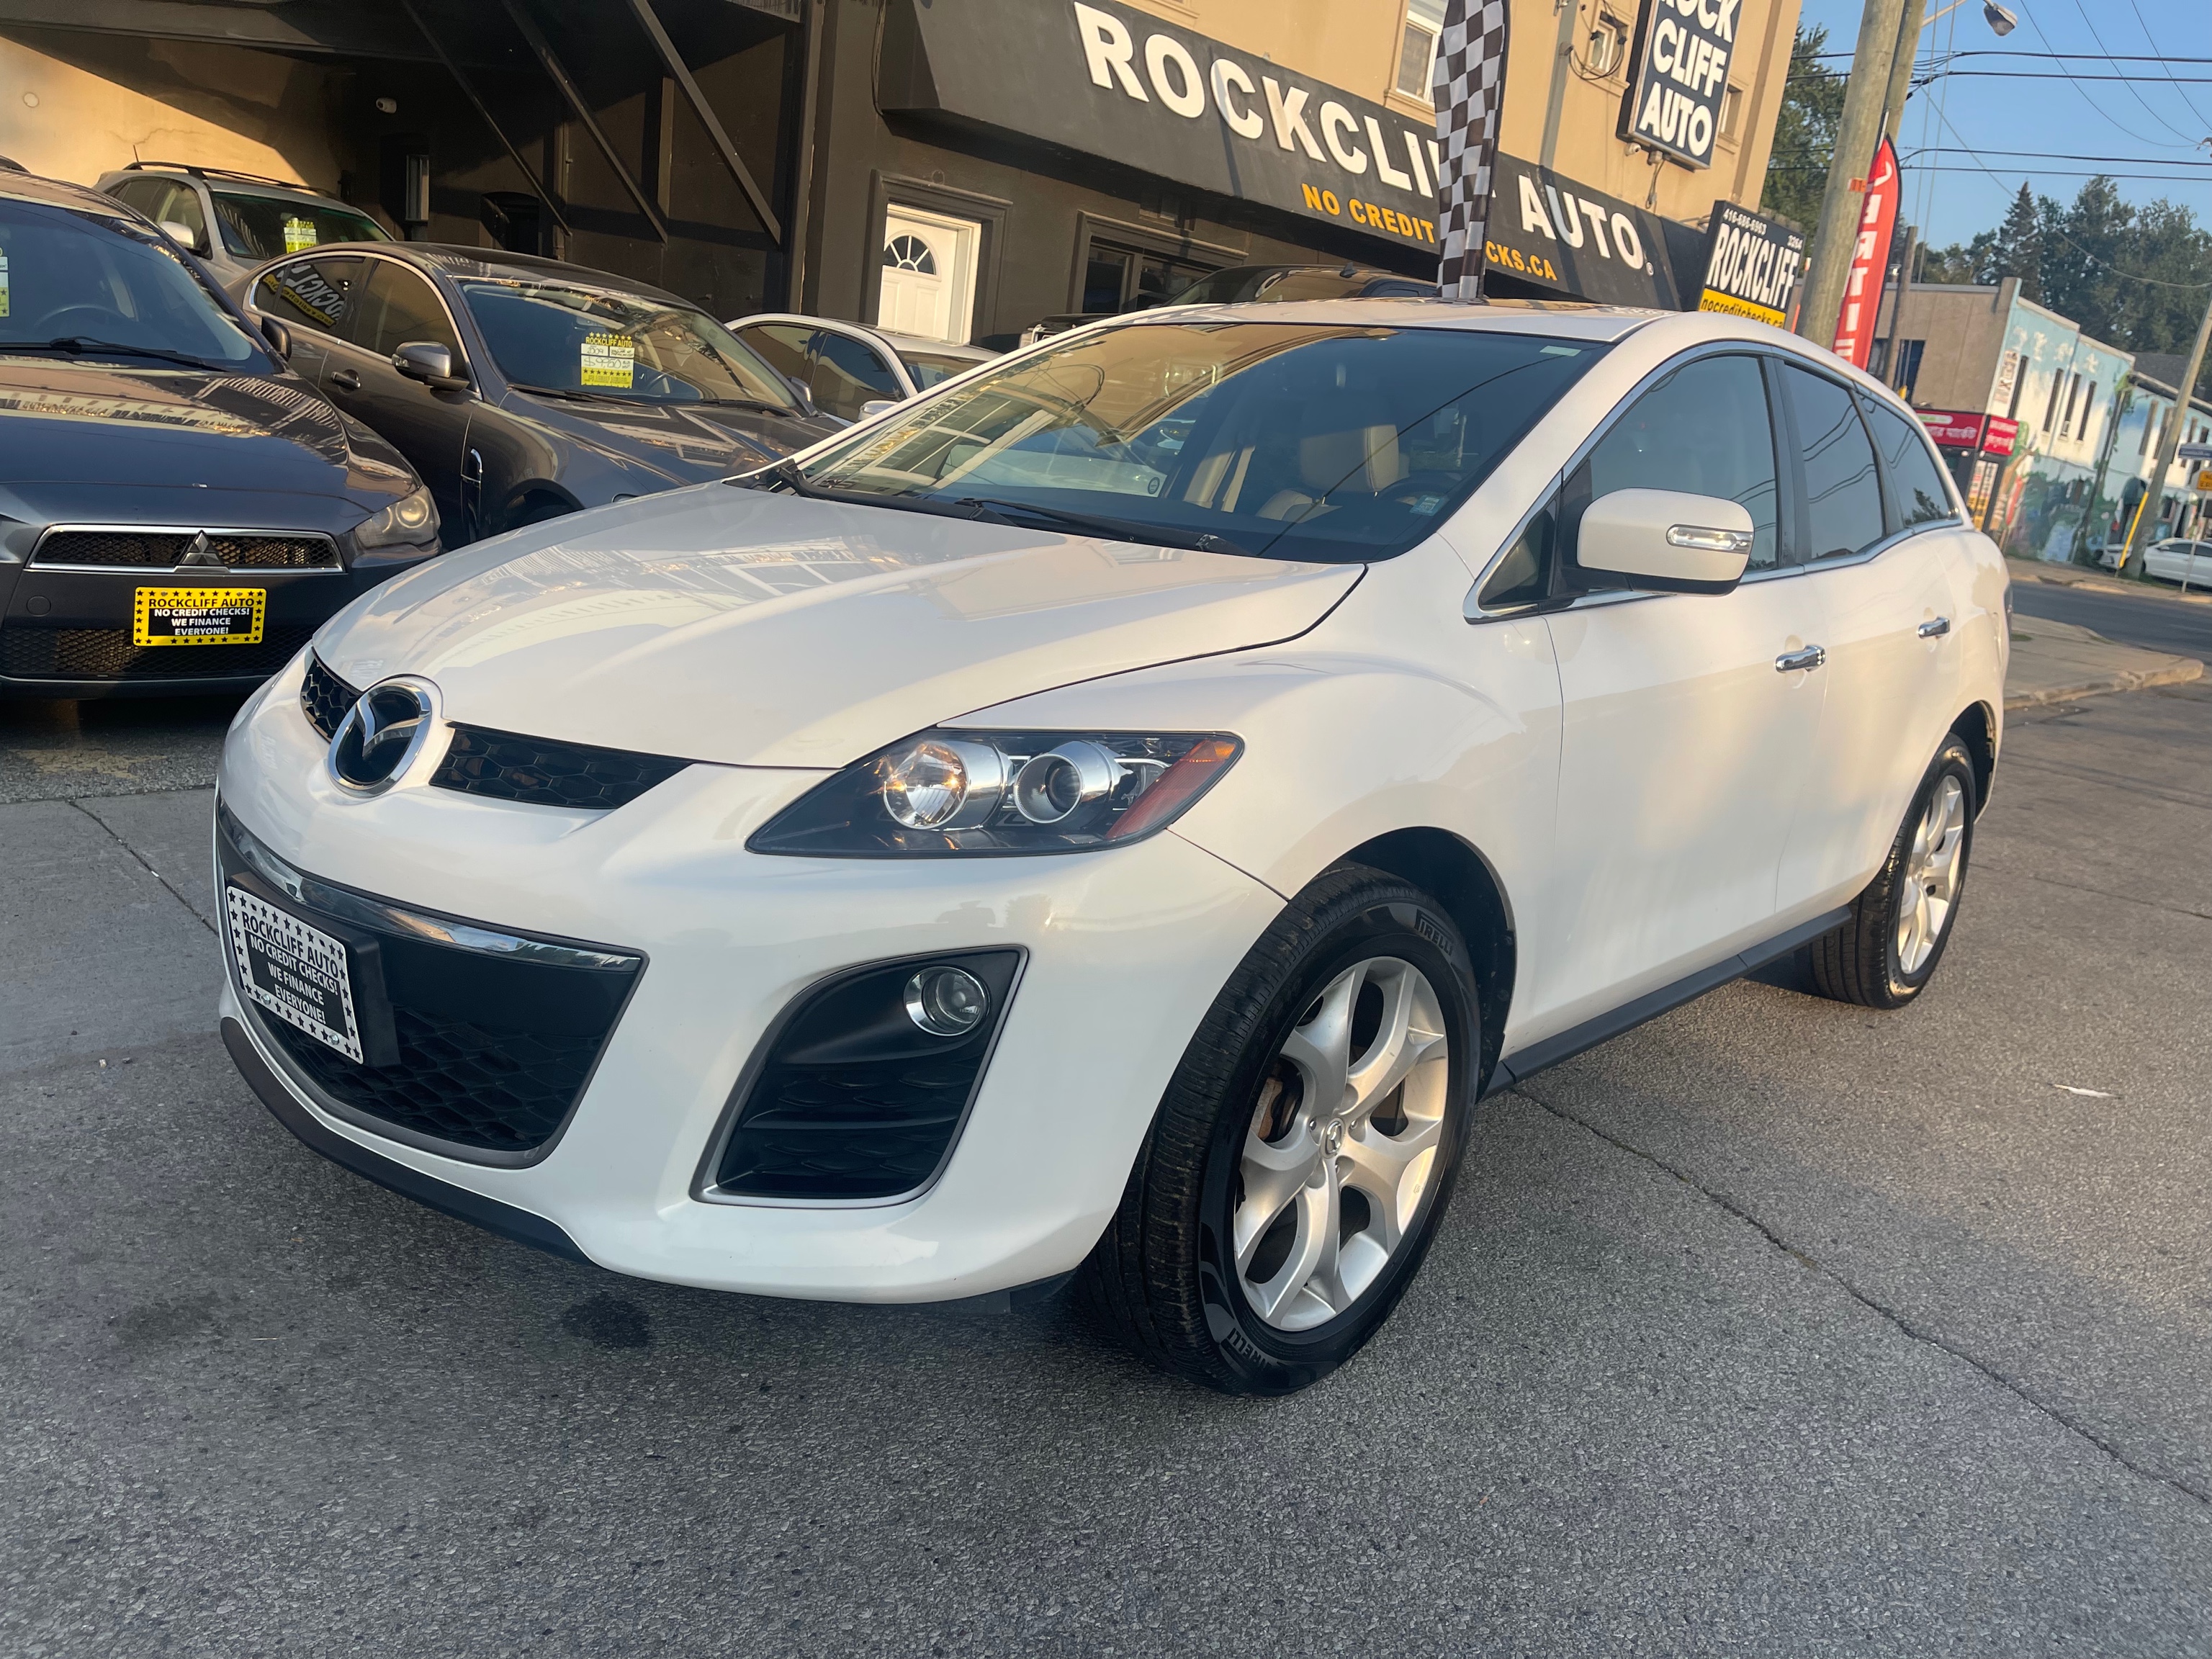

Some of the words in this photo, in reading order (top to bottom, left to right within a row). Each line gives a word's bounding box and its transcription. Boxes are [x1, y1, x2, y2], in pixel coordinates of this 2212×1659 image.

[1660, 0, 1737, 43] CK
[1653, 18, 1727, 98] CLIFF
[1074, 1, 1496, 199] ROCKCLI
[1519, 175, 1645, 270] AUTO
[1639, 81, 1713, 156] AUTO
[1301, 183, 1341, 215] NO
[1349, 199, 1435, 243] CREDIT
[1485, 240, 1557, 281] CKS.CA
[1705, 222, 1800, 310] ROCKCLIFF
[585, 336, 616, 346] ROCKCLIFF
[149, 598, 217, 607] ROCKCLIFF
[242, 911, 304, 958] ROCKCLIFF
[307, 946, 338, 978] AUTO
[1414, 909, 1455, 956] PIRELLI
[251, 934, 264, 953] NO
[266, 945, 297, 972] CREDIT
[299, 962, 338, 996] CHECKS!
[267, 961, 283, 982] WE
[284, 971, 324, 1005] FINANCE
[274, 984, 326, 1025] EVERYONE!
